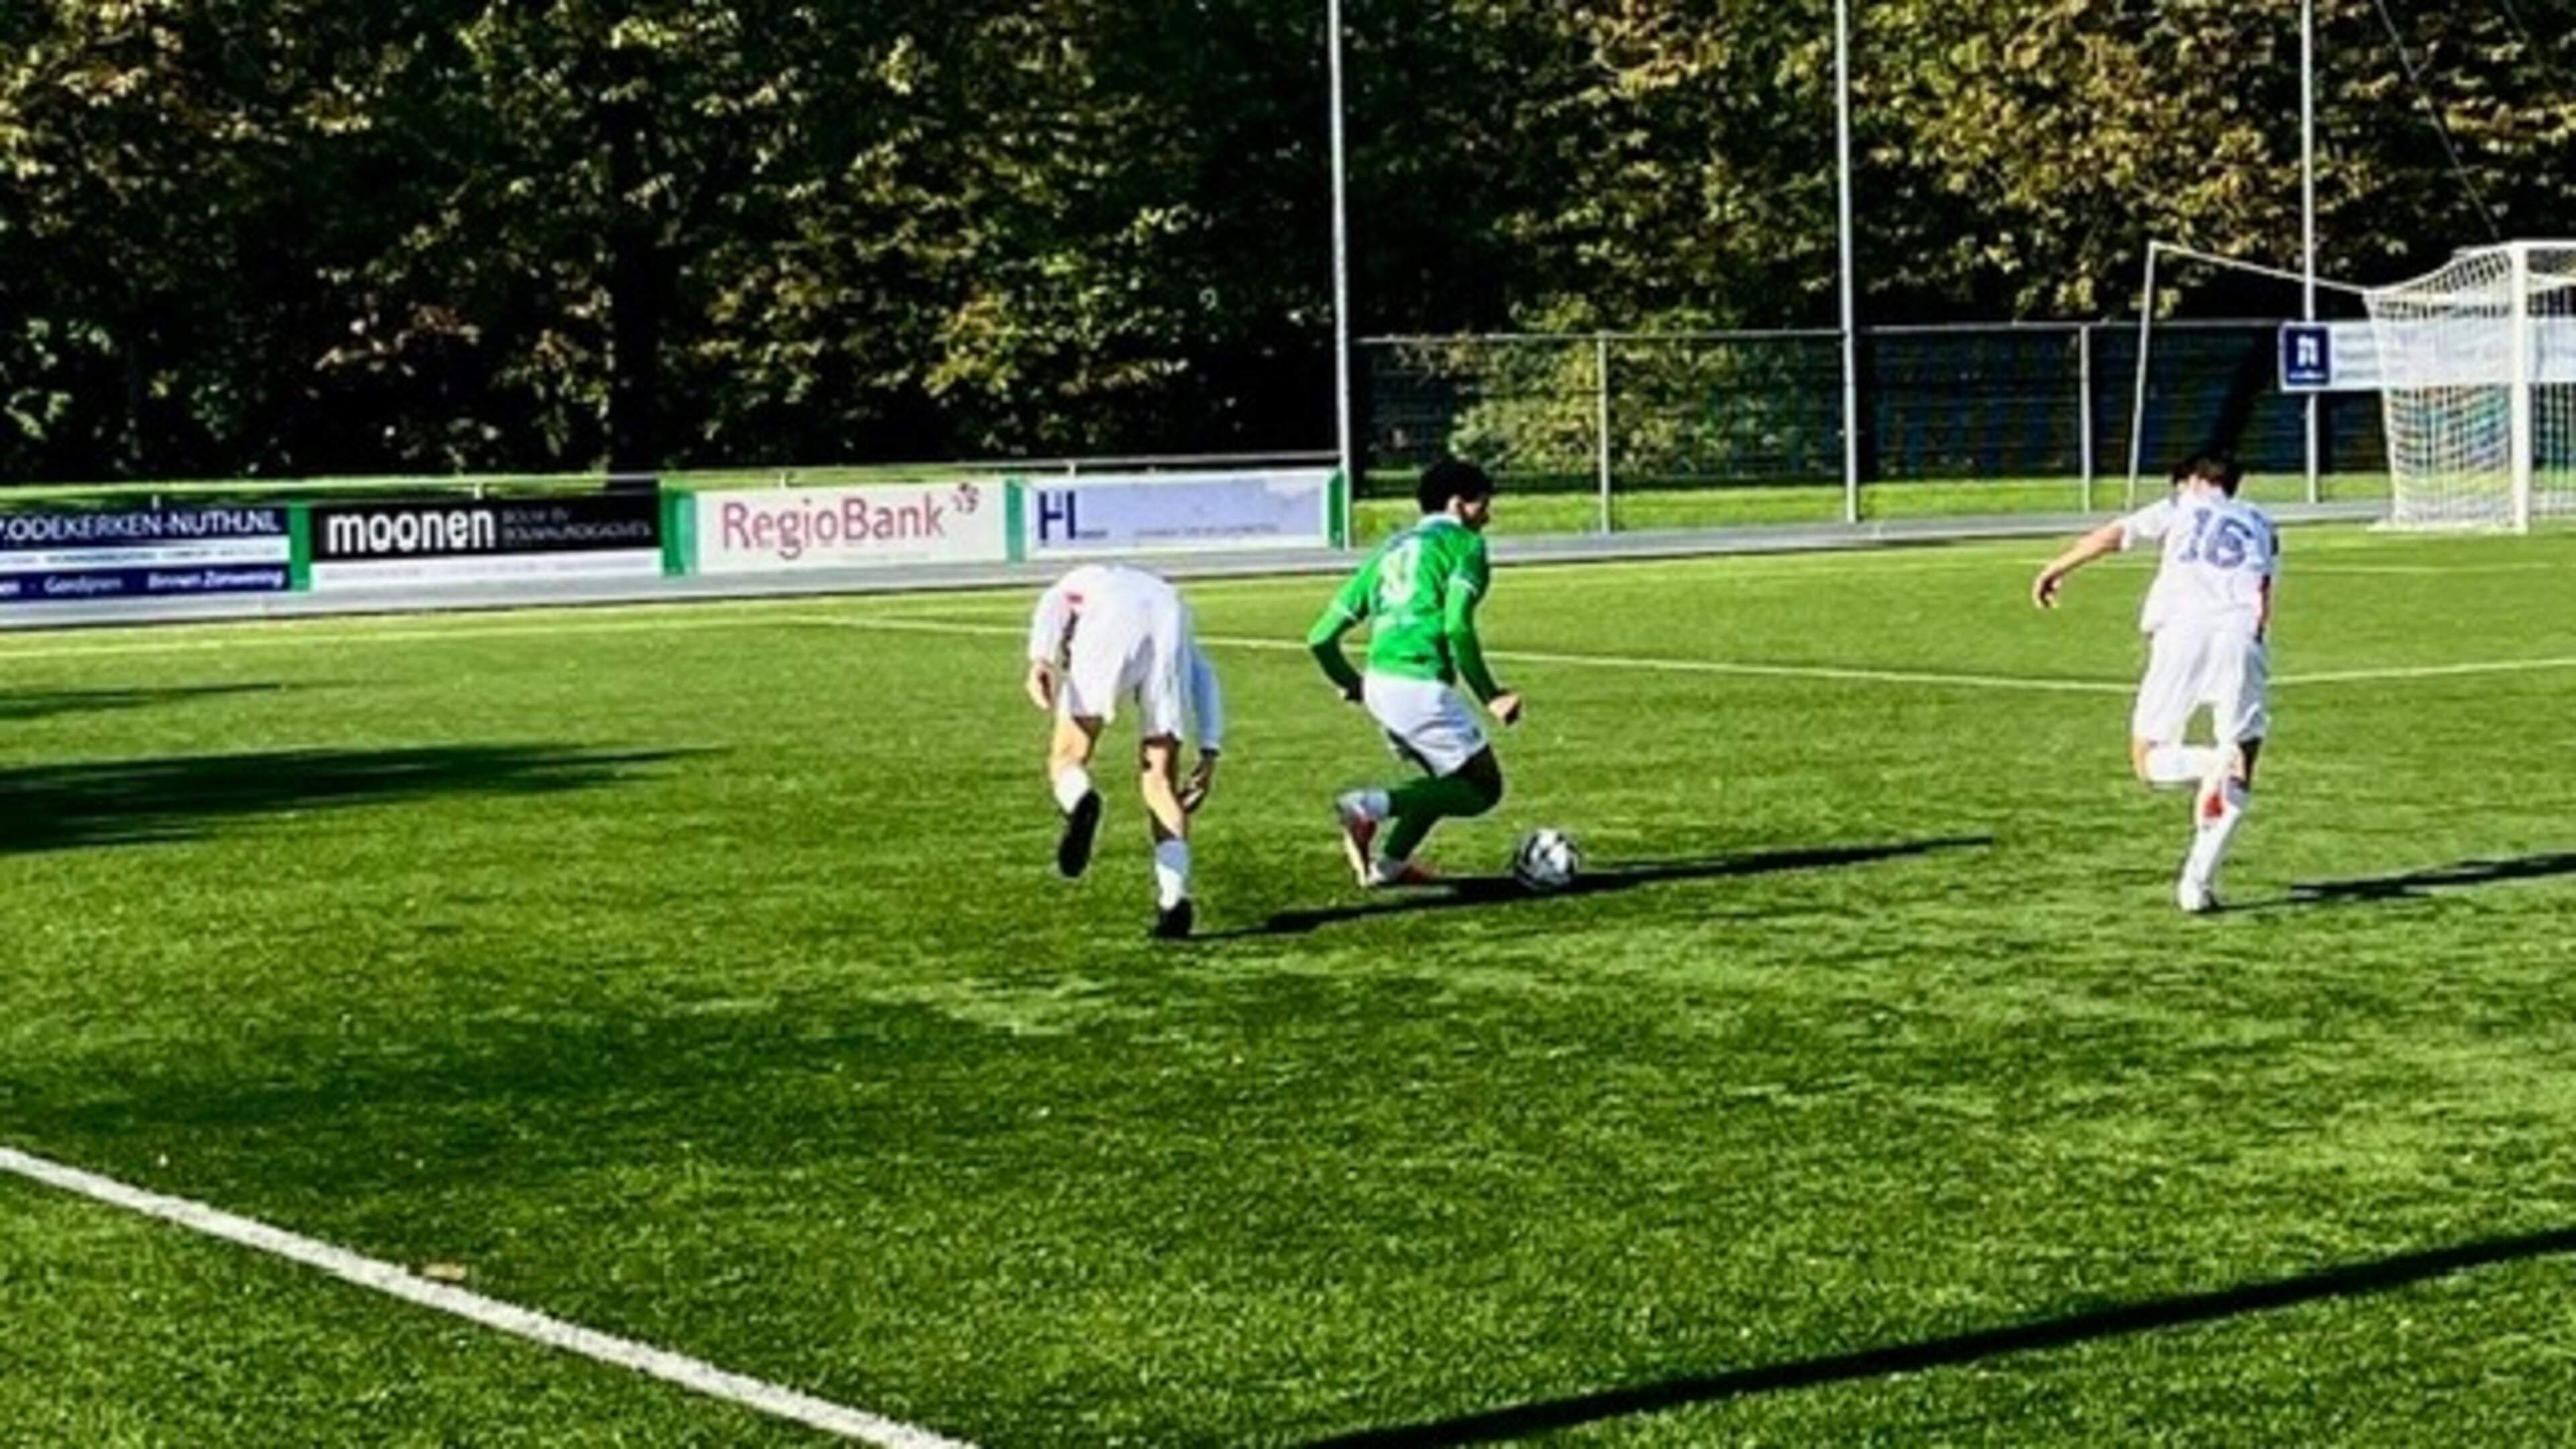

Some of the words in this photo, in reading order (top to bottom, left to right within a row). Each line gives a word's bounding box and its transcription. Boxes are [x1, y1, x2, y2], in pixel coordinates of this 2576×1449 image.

[327, 508, 495, 553] moonen
[721, 492, 944, 560] RegioBank
[2178, 507, 2253, 568] 16
